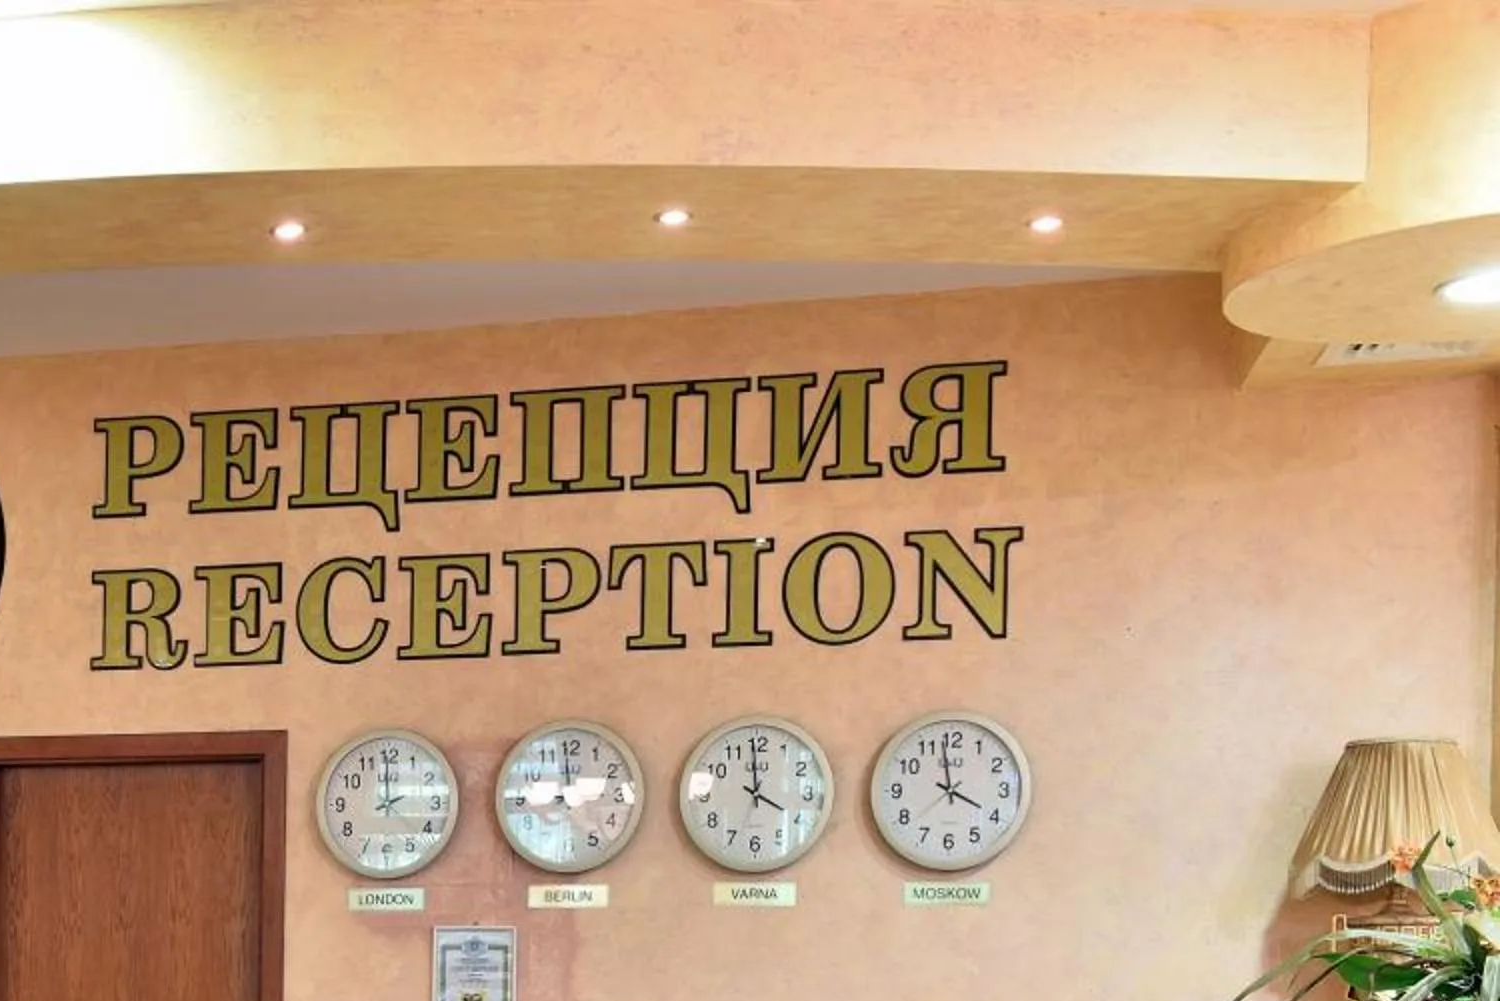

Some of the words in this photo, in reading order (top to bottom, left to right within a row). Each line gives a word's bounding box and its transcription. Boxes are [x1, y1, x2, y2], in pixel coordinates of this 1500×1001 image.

[90, 360, 1008, 532] РЕЦЕПЦИЯ
[89, 525, 1024, 672] RECEPTION
[562, 739, 580, 756] 12
[748, 736, 769, 753] 12
[918, 740, 935, 755] 11
[943, 731, 963, 748] 12
[380, 748, 399, 764] 12
[540, 748, 555, 764] 11
[725, 745, 741, 760] 11
[359, 756, 374, 771] 11
[607, 763, 619, 779] 2
[707, 762, 727, 779] 10
[795, 761, 807, 777] 2
[900, 758, 920, 774] 10
[991, 757, 1003, 773] 2
[344, 773, 361, 789] 10
[424, 772, 435, 786] 2
[613, 787, 625, 803] 3
[802, 785, 813, 802] 3
[891, 783, 903, 799] 9
[998, 782, 1010, 799] 3
[335, 797, 345, 813] 9
[430, 795, 441, 810] 3
[605, 812, 616, 828] 4
[707, 811, 718, 828] 8
[899, 808, 910, 825] 8
[989, 808, 999, 824] 4
[342, 821, 353, 837] 8
[423, 820, 432, 834] 4
[919, 826, 930, 843] 7
[969, 826, 981, 843] 5
[405, 838, 415, 852] 5
[587, 831, 599, 847] 5
[726, 829, 738, 846] 7
[749, 835, 761, 853] 6
[943, 833, 954, 850] 6
[357, 892, 415, 906] LONDON
[543, 889, 594, 904] BERLIN
[730, 888, 779, 901] VARNA
[912, 887, 982, 901] MOSKOW
